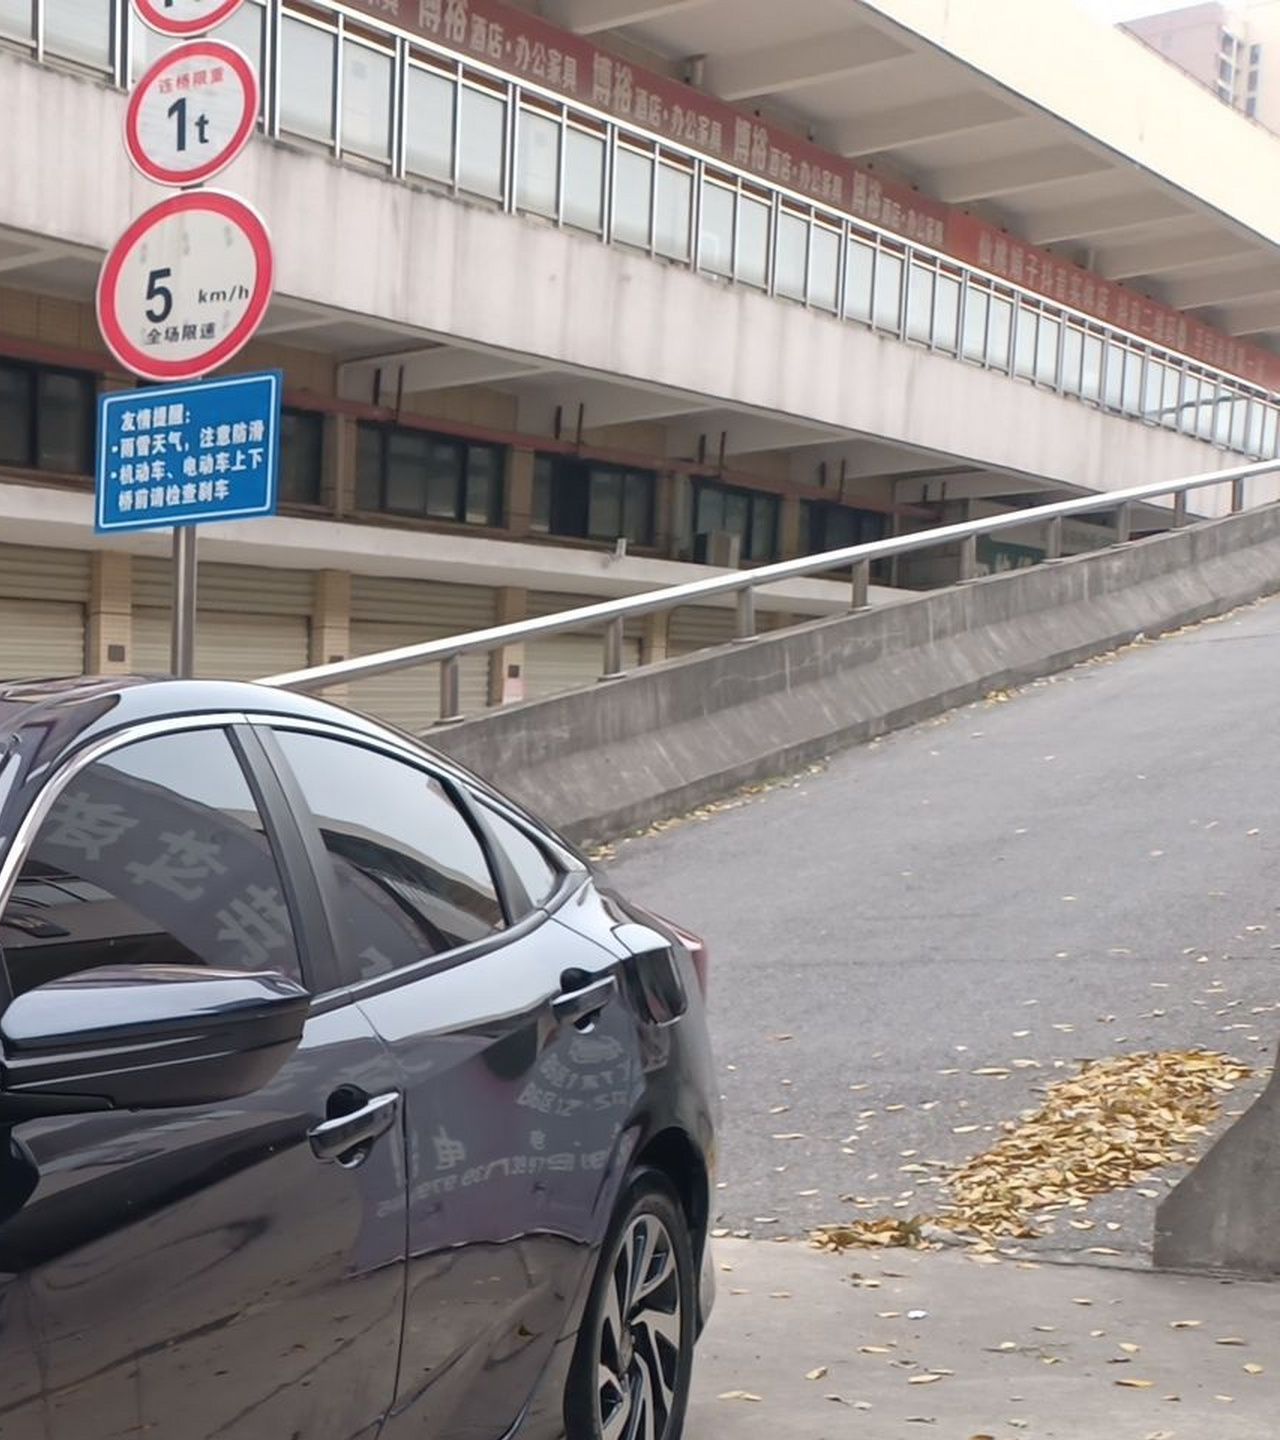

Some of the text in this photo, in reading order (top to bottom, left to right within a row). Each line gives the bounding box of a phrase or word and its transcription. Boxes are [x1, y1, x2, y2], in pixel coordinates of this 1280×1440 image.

[145, 267, 249, 324] 5 km/h
[144, 322, 215, 345] 全场限速
